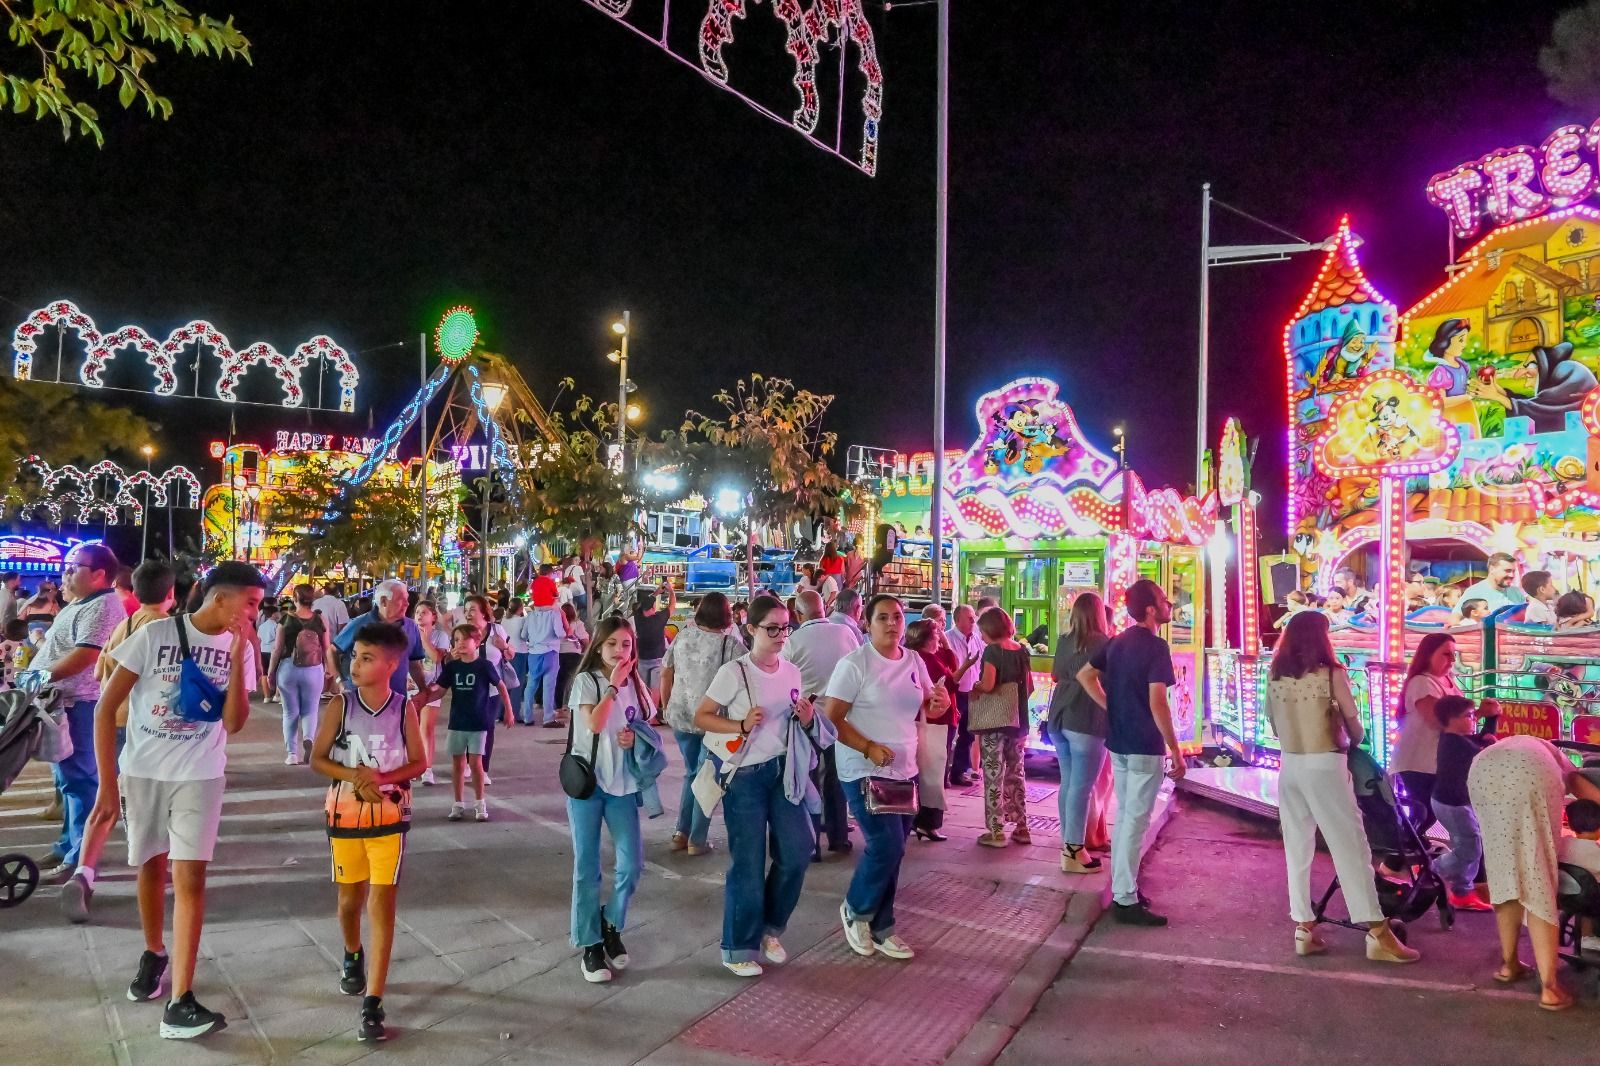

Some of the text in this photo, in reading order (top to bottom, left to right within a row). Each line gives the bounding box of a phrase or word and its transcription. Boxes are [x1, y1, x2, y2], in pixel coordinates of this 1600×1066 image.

[1427, 117, 1600, 238] TRE
[276, 430, 401, 460] HAPPY FAMY
[654, 564, 680, 574] SALIDA
[1532, 705, 1549, 720] DE
[1496, 719, 1510, 734] LA
